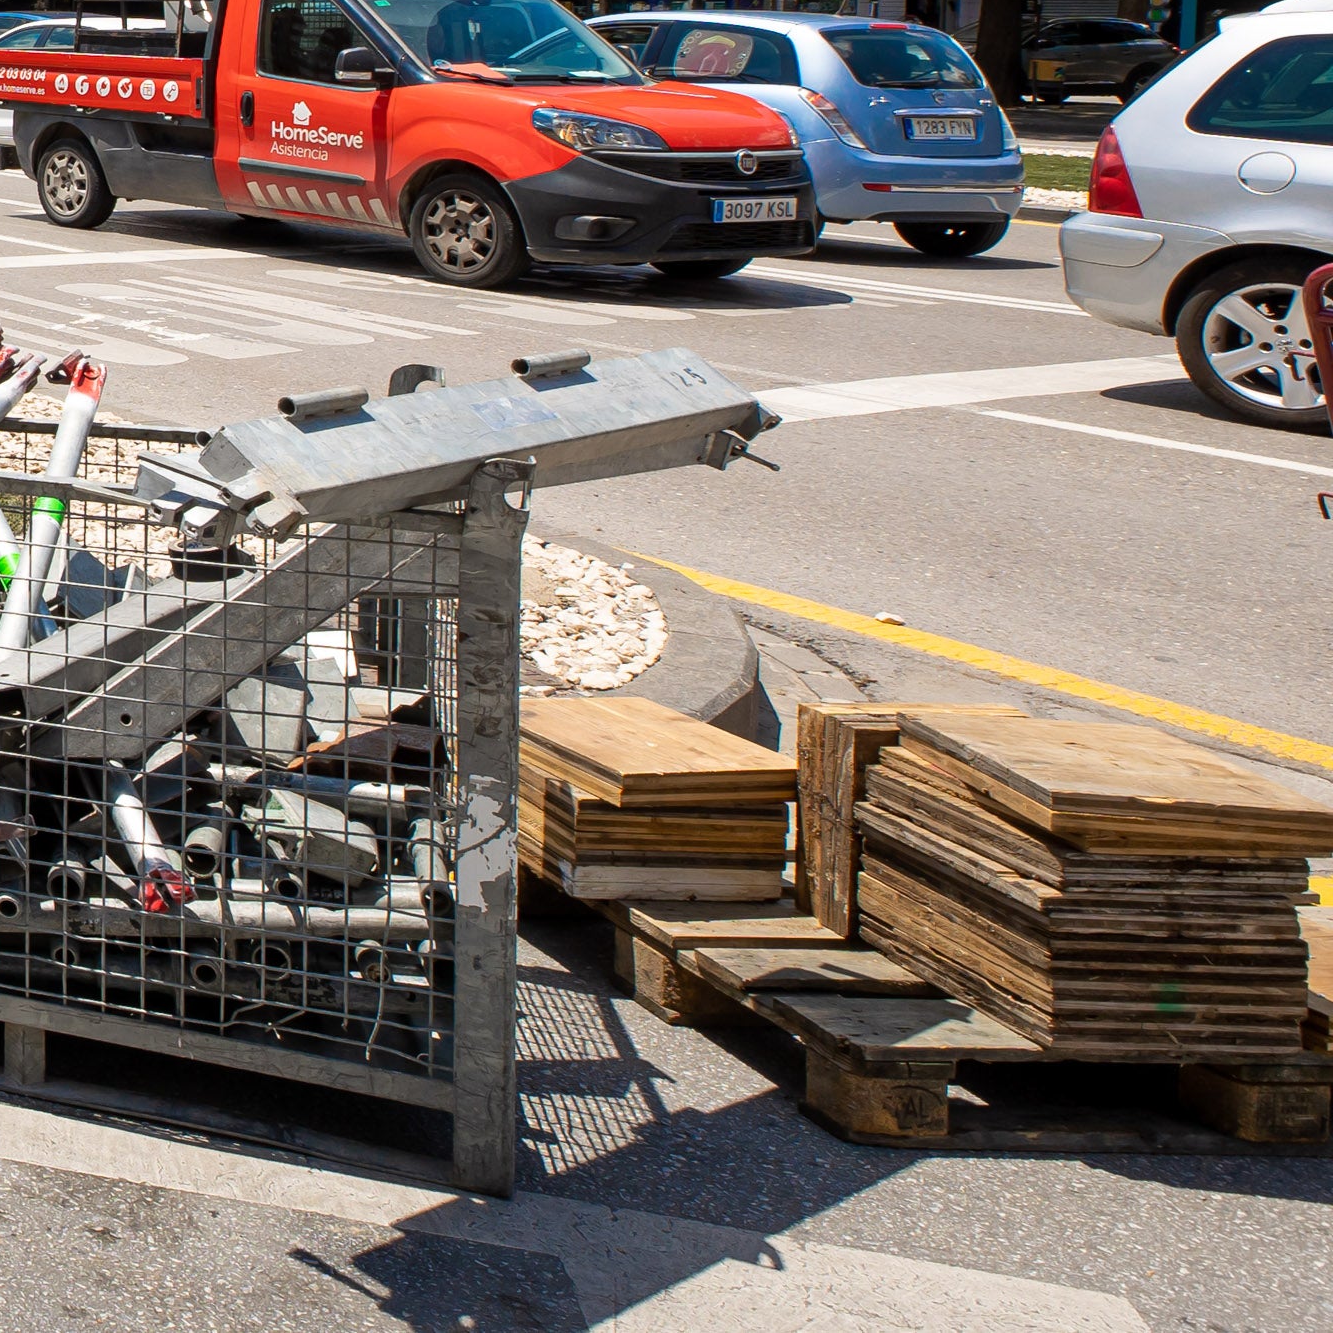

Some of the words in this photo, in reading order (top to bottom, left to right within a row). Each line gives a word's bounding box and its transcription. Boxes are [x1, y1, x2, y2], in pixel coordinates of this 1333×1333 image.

[6, 67, 19, 80] 03
[20, 68, 33, 81] 03
[33, 69, 47, 82] 04
[271, 120, 364, 150] HomeServe
[916, 120, 947, 135] 1283
[949, 120, 972, 135] FYN
[270, 140, 329, 161] Asistencia
[724, 202, 764, 219] 3097
[766, 201, 794, 218] KSL
